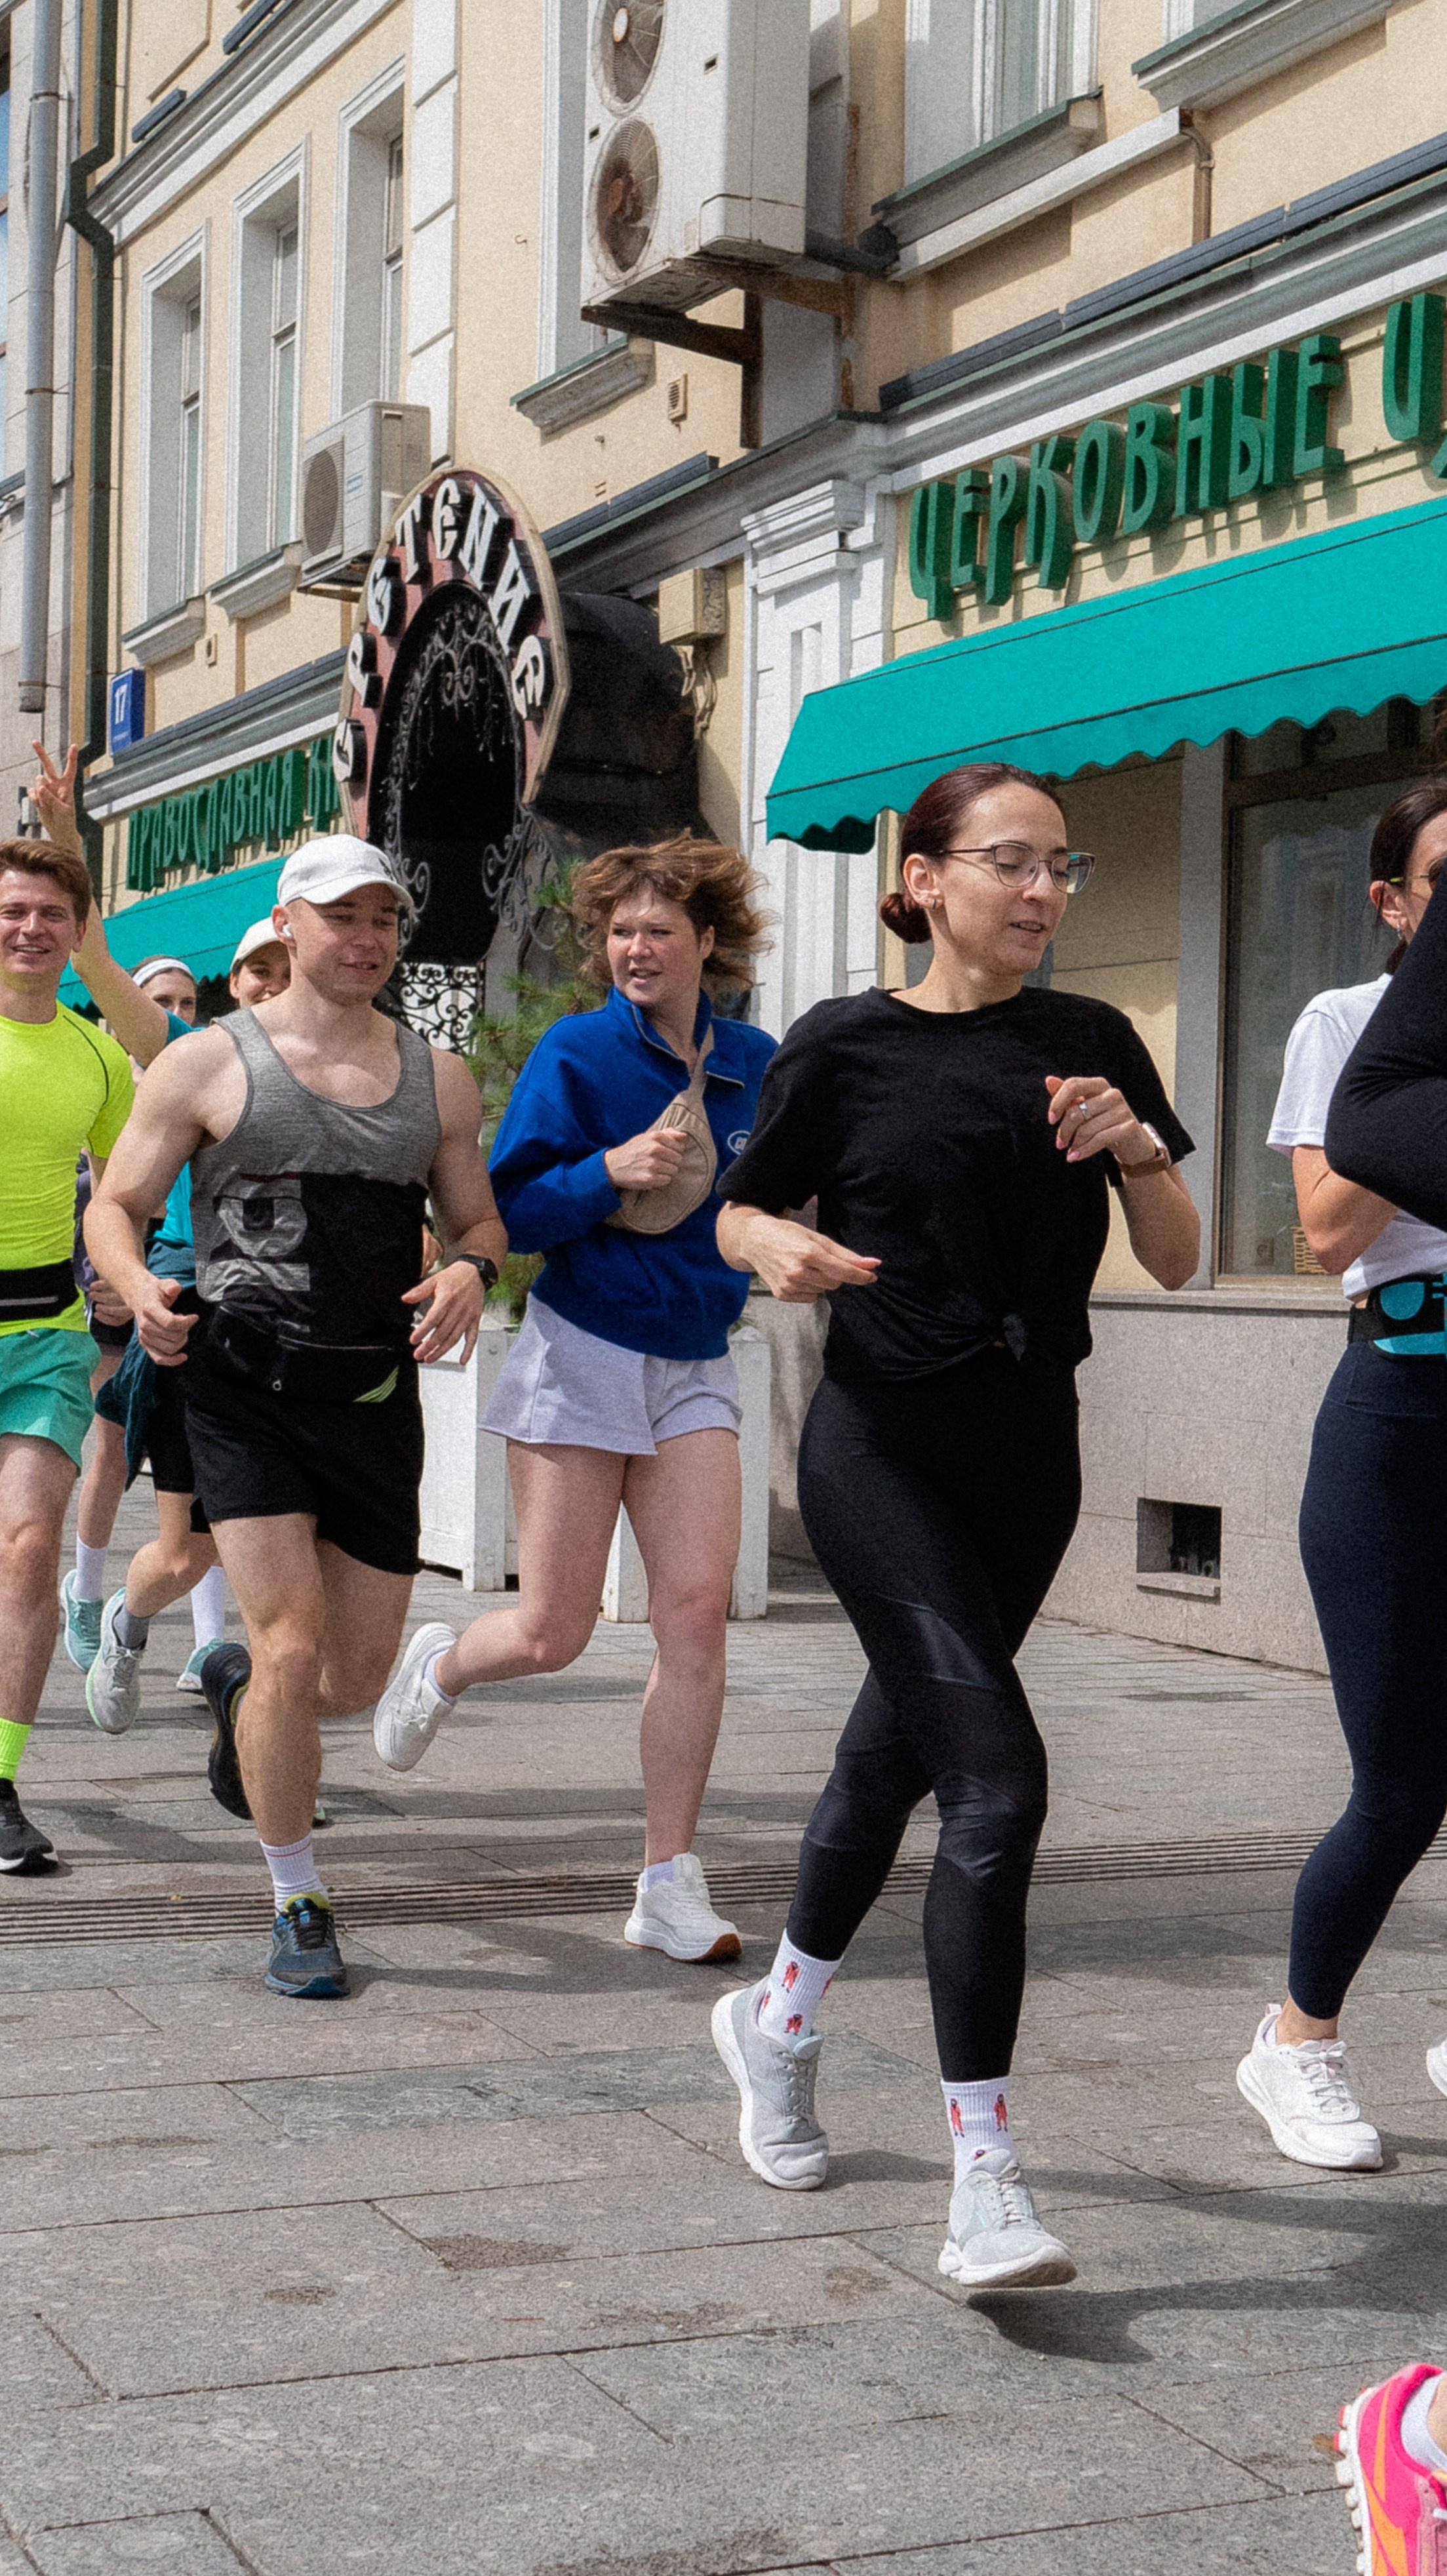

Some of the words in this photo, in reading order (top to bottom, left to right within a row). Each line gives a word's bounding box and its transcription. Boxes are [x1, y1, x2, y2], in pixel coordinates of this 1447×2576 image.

[909, 334, 1345, 621] ЦЕРКОВНЫЕ
[115, 683, 128, 725] 17
[127, 750, 304, 892] ПРАВОСЛАВНАЯ
